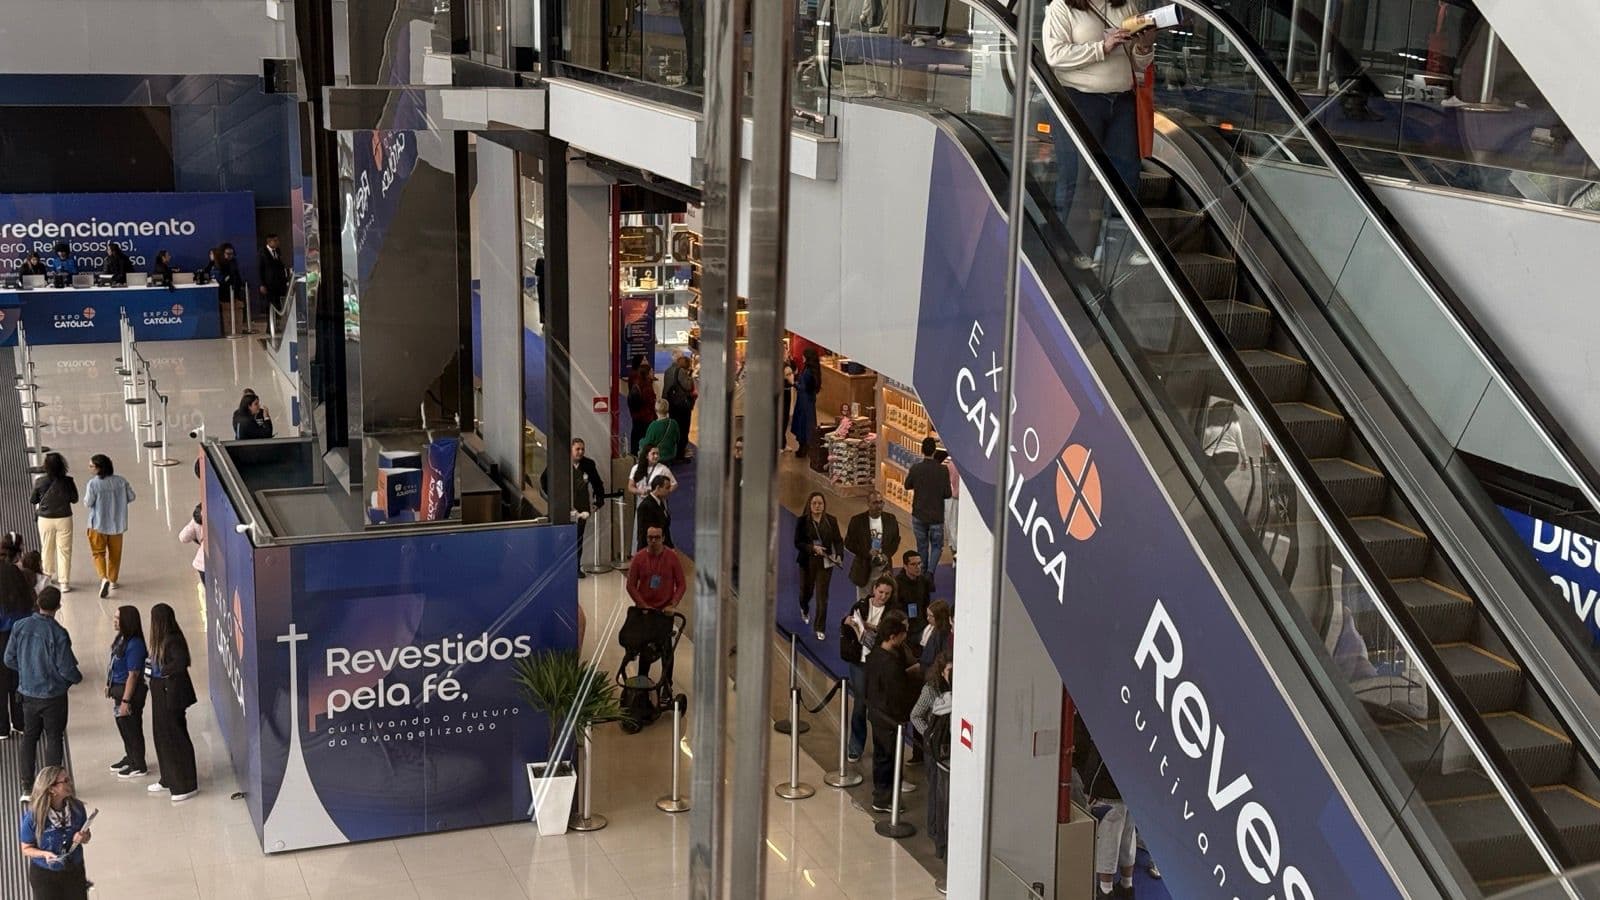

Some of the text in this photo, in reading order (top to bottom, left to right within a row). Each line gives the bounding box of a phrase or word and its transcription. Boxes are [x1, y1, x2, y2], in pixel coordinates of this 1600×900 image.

[0, 217, 195, 238] redenciamento
[54, 320, 94, 328] CATÓLICA
[143, 317, 183, 325] CATÓLICA
[326, 632, 532, 676] Revestidos
[327, 671, 469, 719] pela fé,
[328, 716, 431, 734] cultivando
[462, 707, 519, 720] futuro
[328, 722, 496, 748] da evangelização
